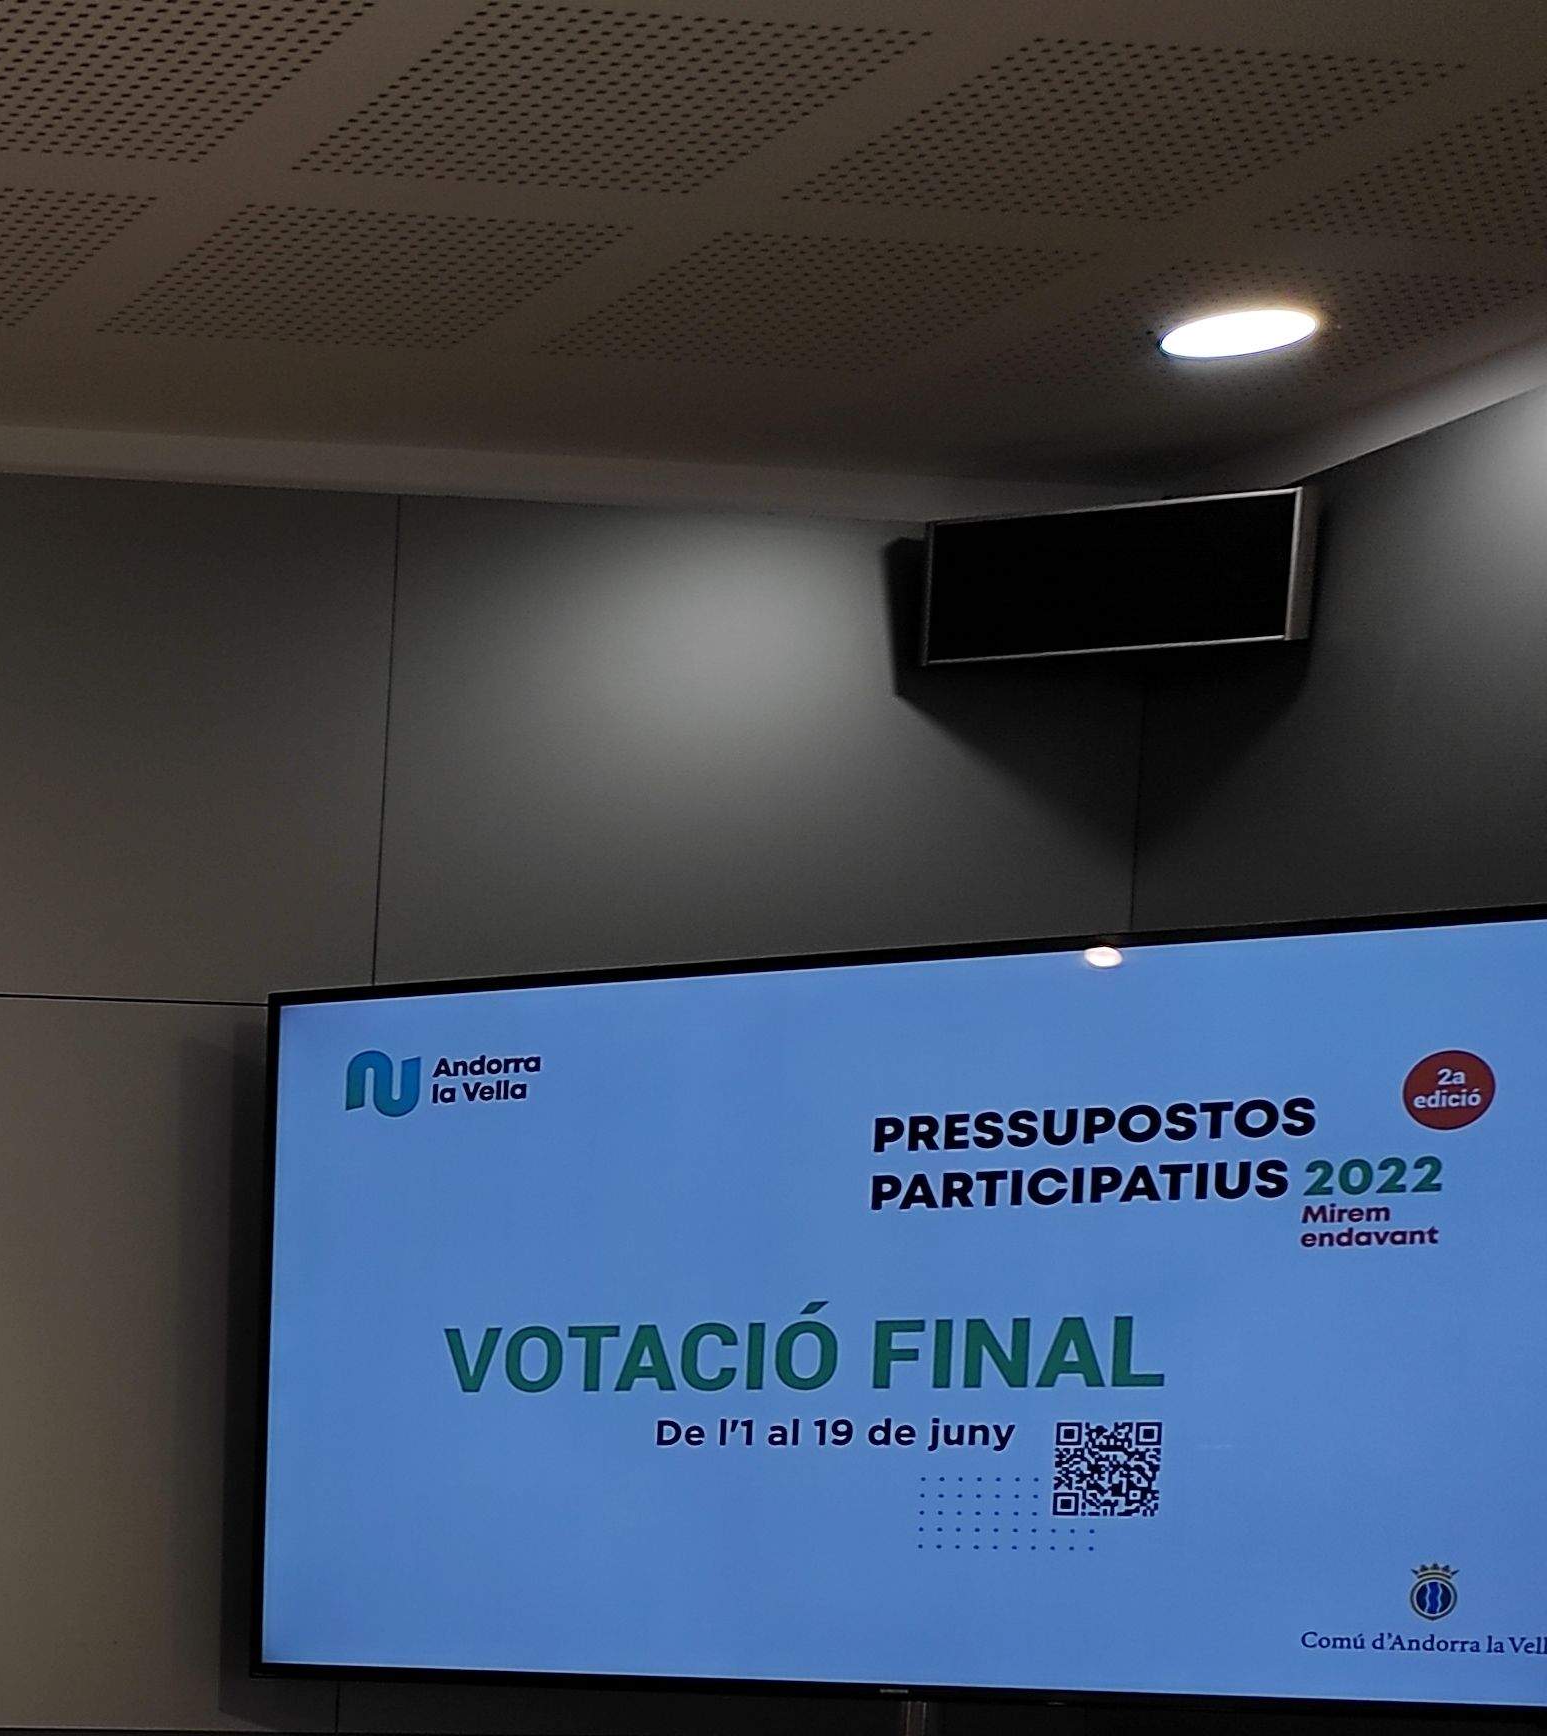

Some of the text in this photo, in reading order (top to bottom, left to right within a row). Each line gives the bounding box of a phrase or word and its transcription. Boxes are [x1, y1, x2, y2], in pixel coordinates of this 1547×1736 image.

[432, 1053, 542, 1078] Andorra
[1437, 1067, 1466, 1086] 2a
[432, 1081, 528, 1104] la Vella
[1412, 1087, 1481, 1110] edició
[872, 1097, 1317, 1153] PRESSUPOSTOS
[869, 1156, 1443, 1211] PARTICIPATIUS 2022
[1301, 1202, 1390, 1225] Mirem
[1300, 1225, 1439, 1248] endavant
[444, 1301, 1165, 1394] VOTACIÓ FINAL
[656, 1417, 1016, 1452] De l'1 al 19 de juny
[1301, 1631, 1365, 1650] Comú
[1486, 1635, 1504, 1654] la
[1508, 1636, 1547, 1655] Vell
